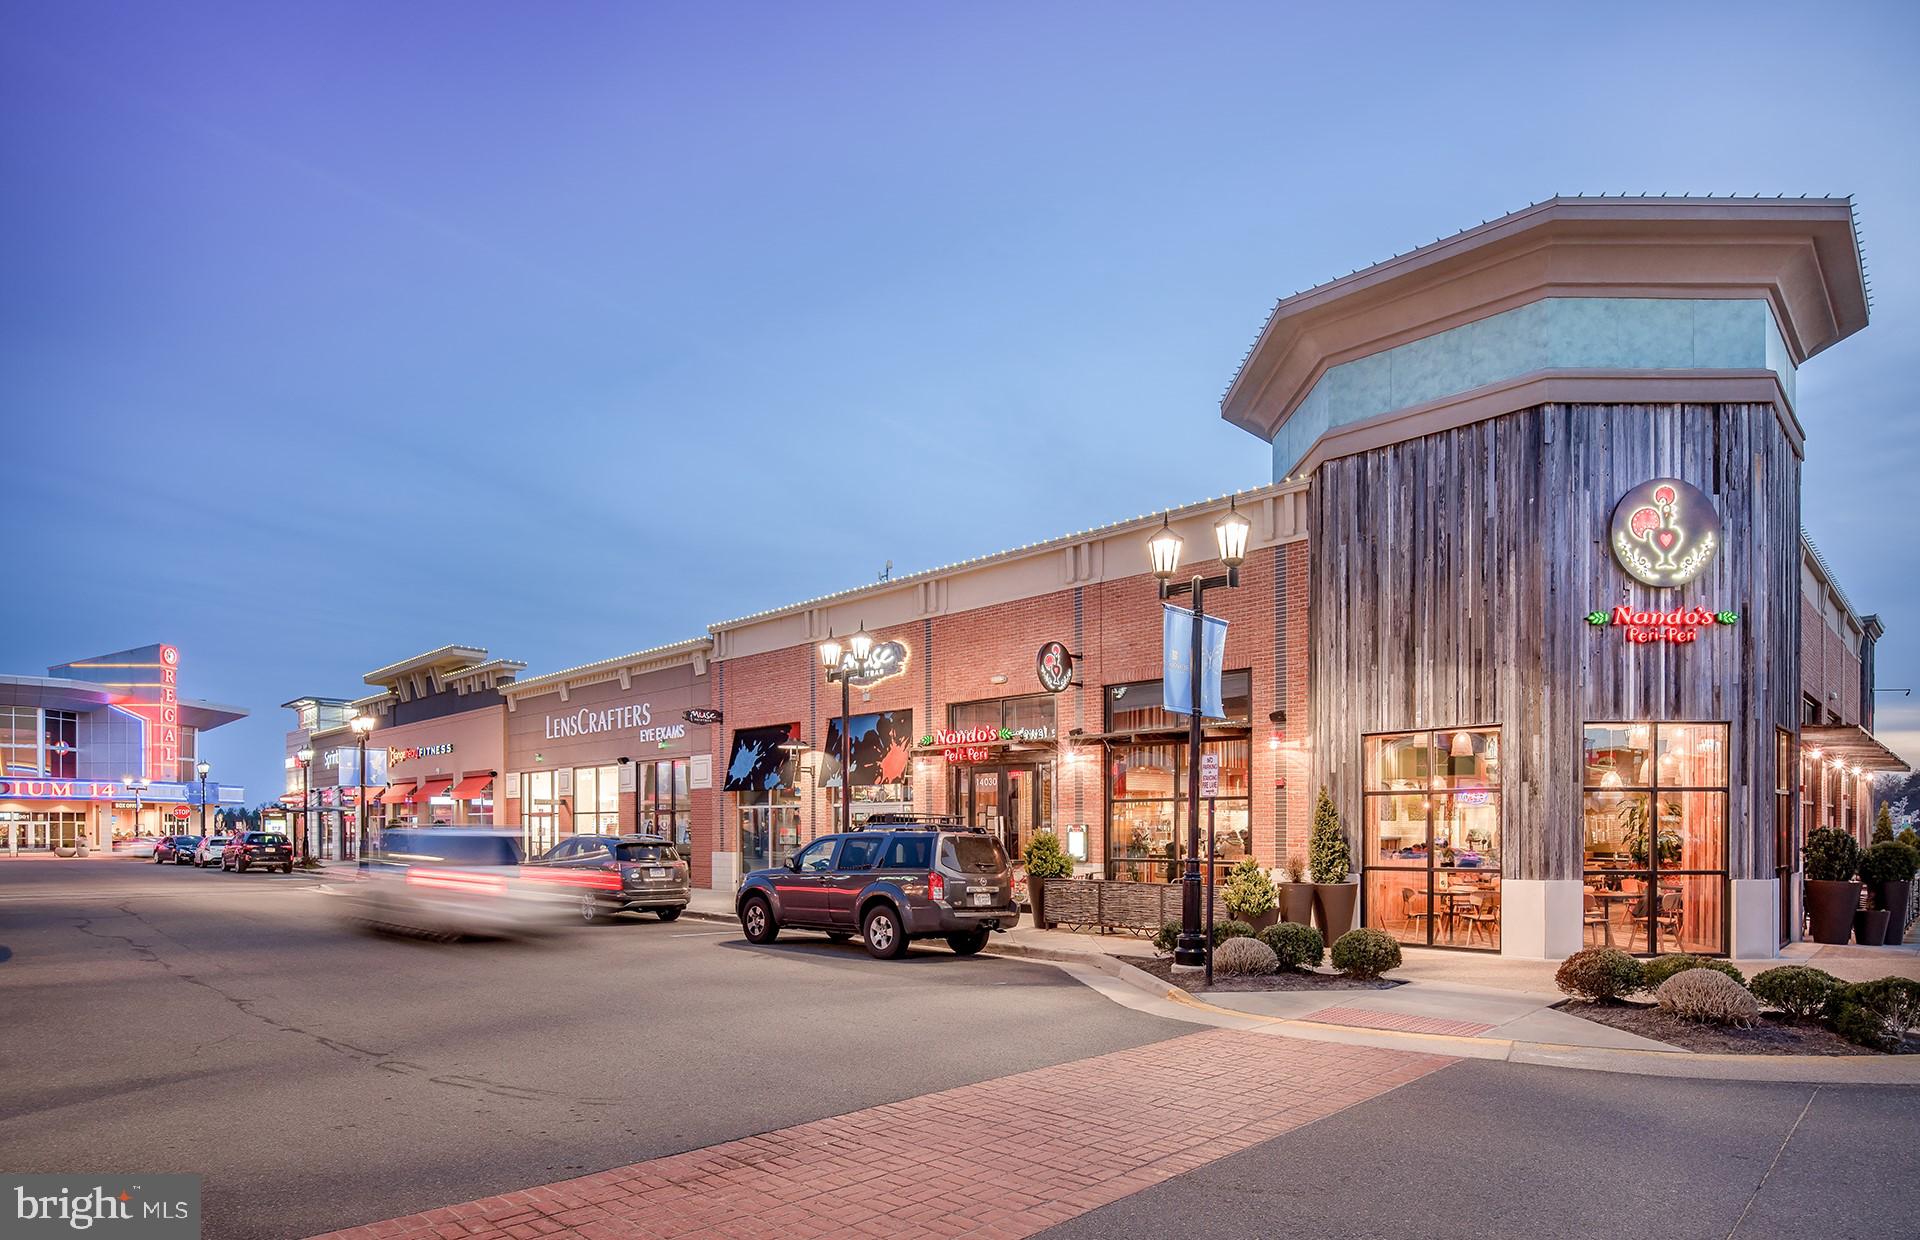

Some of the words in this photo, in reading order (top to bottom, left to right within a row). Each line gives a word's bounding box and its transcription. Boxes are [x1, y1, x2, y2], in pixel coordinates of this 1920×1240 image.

[1613, 605, 1714, 626] Nando's
[1628, 627, 1697, 643] Peri-Peri
[842, 647, 896, 670] Mse
[164, 669, 175, 761] REGAL
[640, 728, 655, 743] EYE
[656, 724, 686, 742] EXAMS
[936, 725, 998, 745] Nando's
[418, 743, 454, 758] FITNESS
[944, 747, 989, 762] Peri-Peri
[90, 782, 115, 798] 14
[975, 777, 998, 787] 14030
[174, 809, 190, 817] STOP
